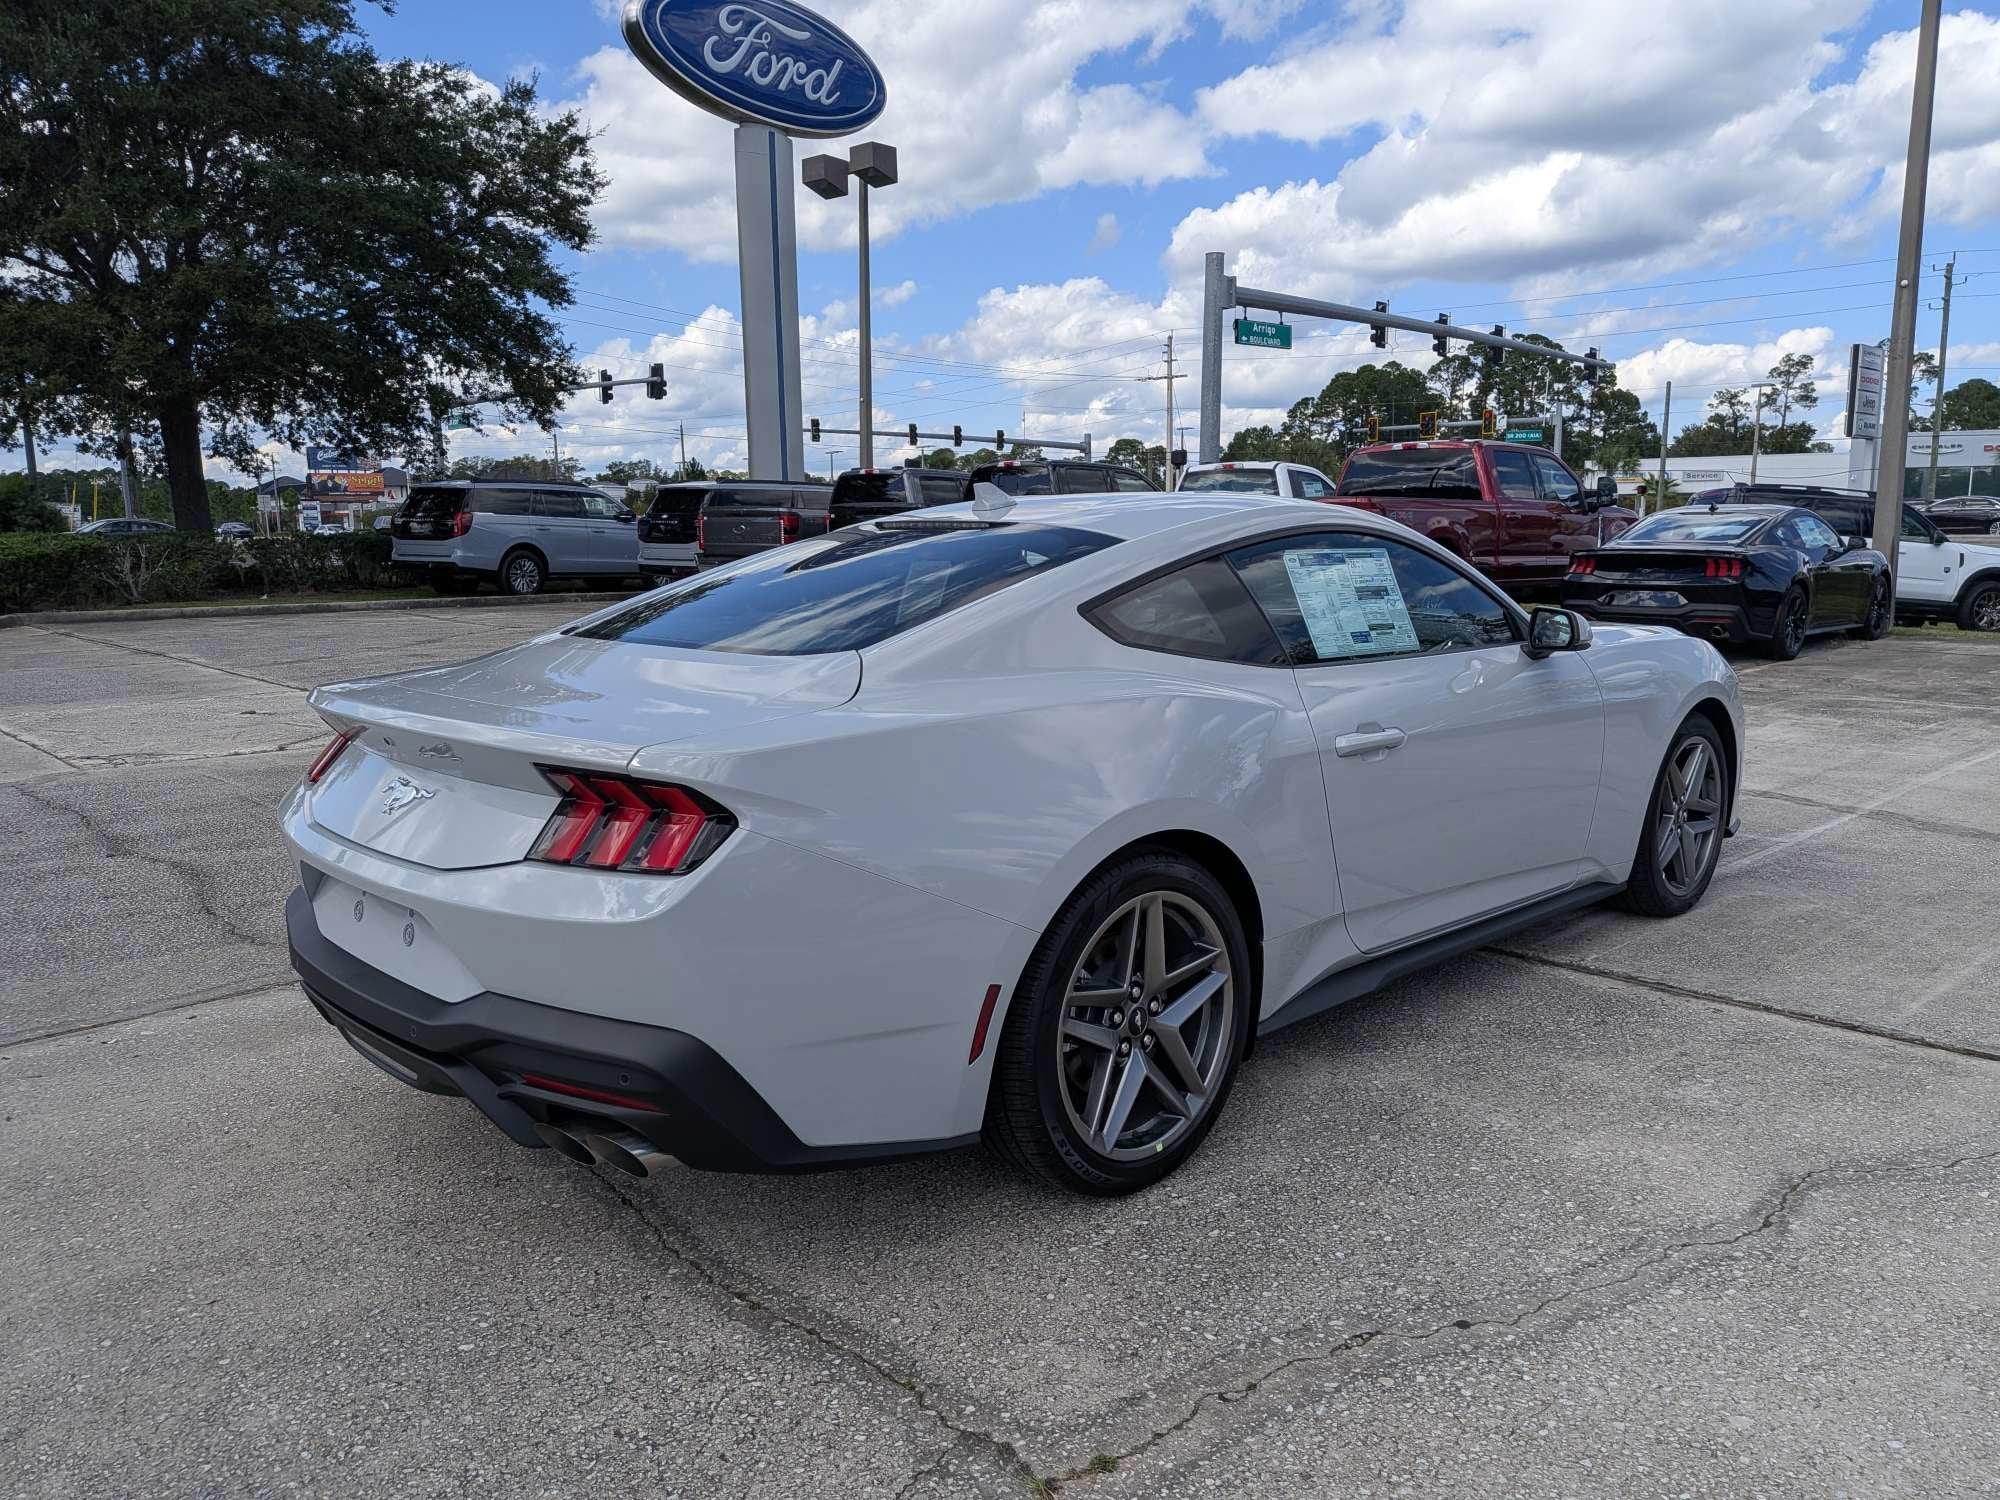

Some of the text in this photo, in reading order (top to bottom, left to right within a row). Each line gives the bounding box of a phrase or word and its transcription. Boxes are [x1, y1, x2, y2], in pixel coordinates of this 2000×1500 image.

[703, 4, 844, 105] Ford
[1253, 323, 1276, 336] Arrigo
[1249, 335, 1281, 346] BOULEVARD
[1863, 395, 1876, 411] Jeep
[1686, 472, 1718, 480] Service
